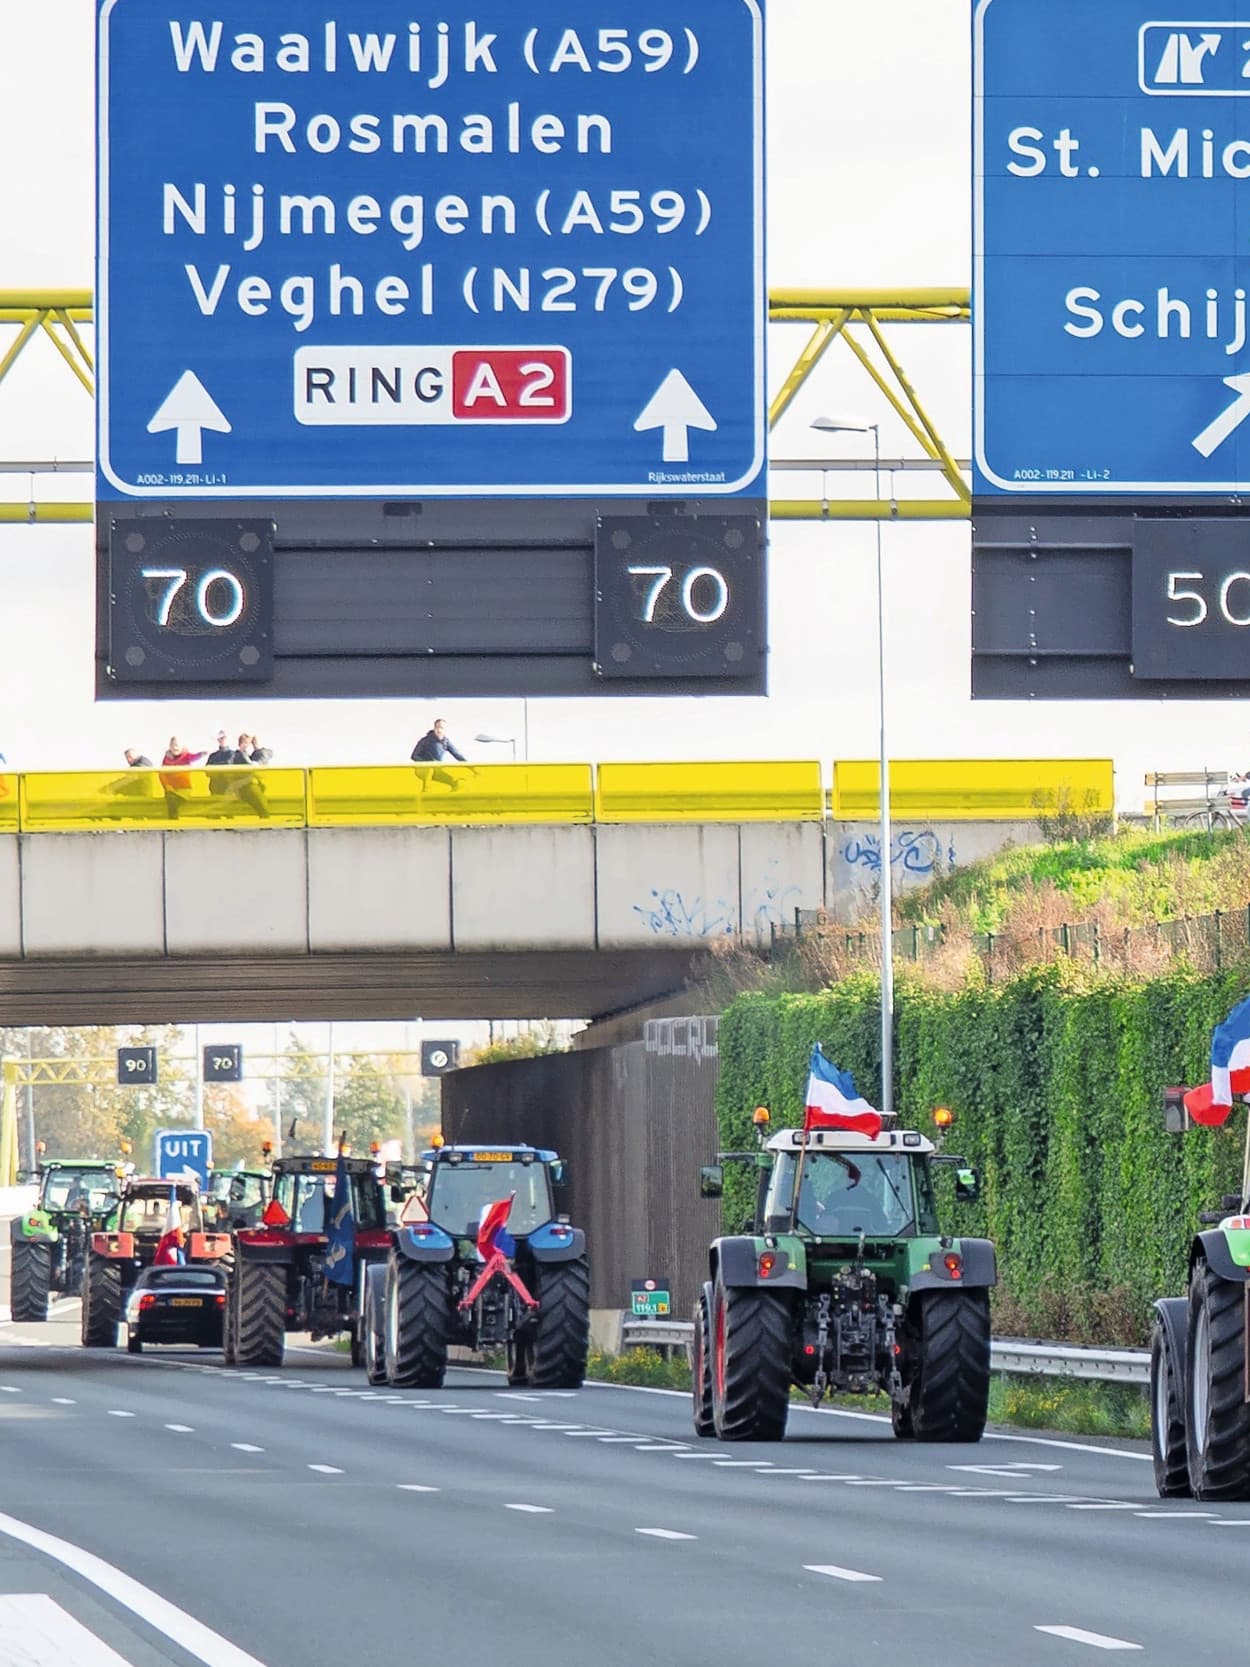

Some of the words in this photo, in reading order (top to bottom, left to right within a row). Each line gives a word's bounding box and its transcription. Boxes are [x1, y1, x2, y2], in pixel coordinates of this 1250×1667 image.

[170, 21, 497, 88] Waalwijk
[524, 28, 699, 74] (A59)
[255, 102, 611, 154] Rosmalen
[1006, 126, 1100, 178] St.
[163, 183, 516, 251] Nijmegen
[535, 189, 711, 236] (A59)
[184, 263, 433, 332] Veghel
[463, 266, 683, 314] (N279)
[306, 367, 444, 404] RING
[463, 362, 555, 407] A2
[648, 471, 726, 484] Rijkswaterstaat
[141, 568, 244, 627] 70
[627, 566, 729, 623] 70
[125, 1060, 146, 1072] 90
[212, 1058, 232, 1070] 70
[165, 1141, 201, 1157] UIT
